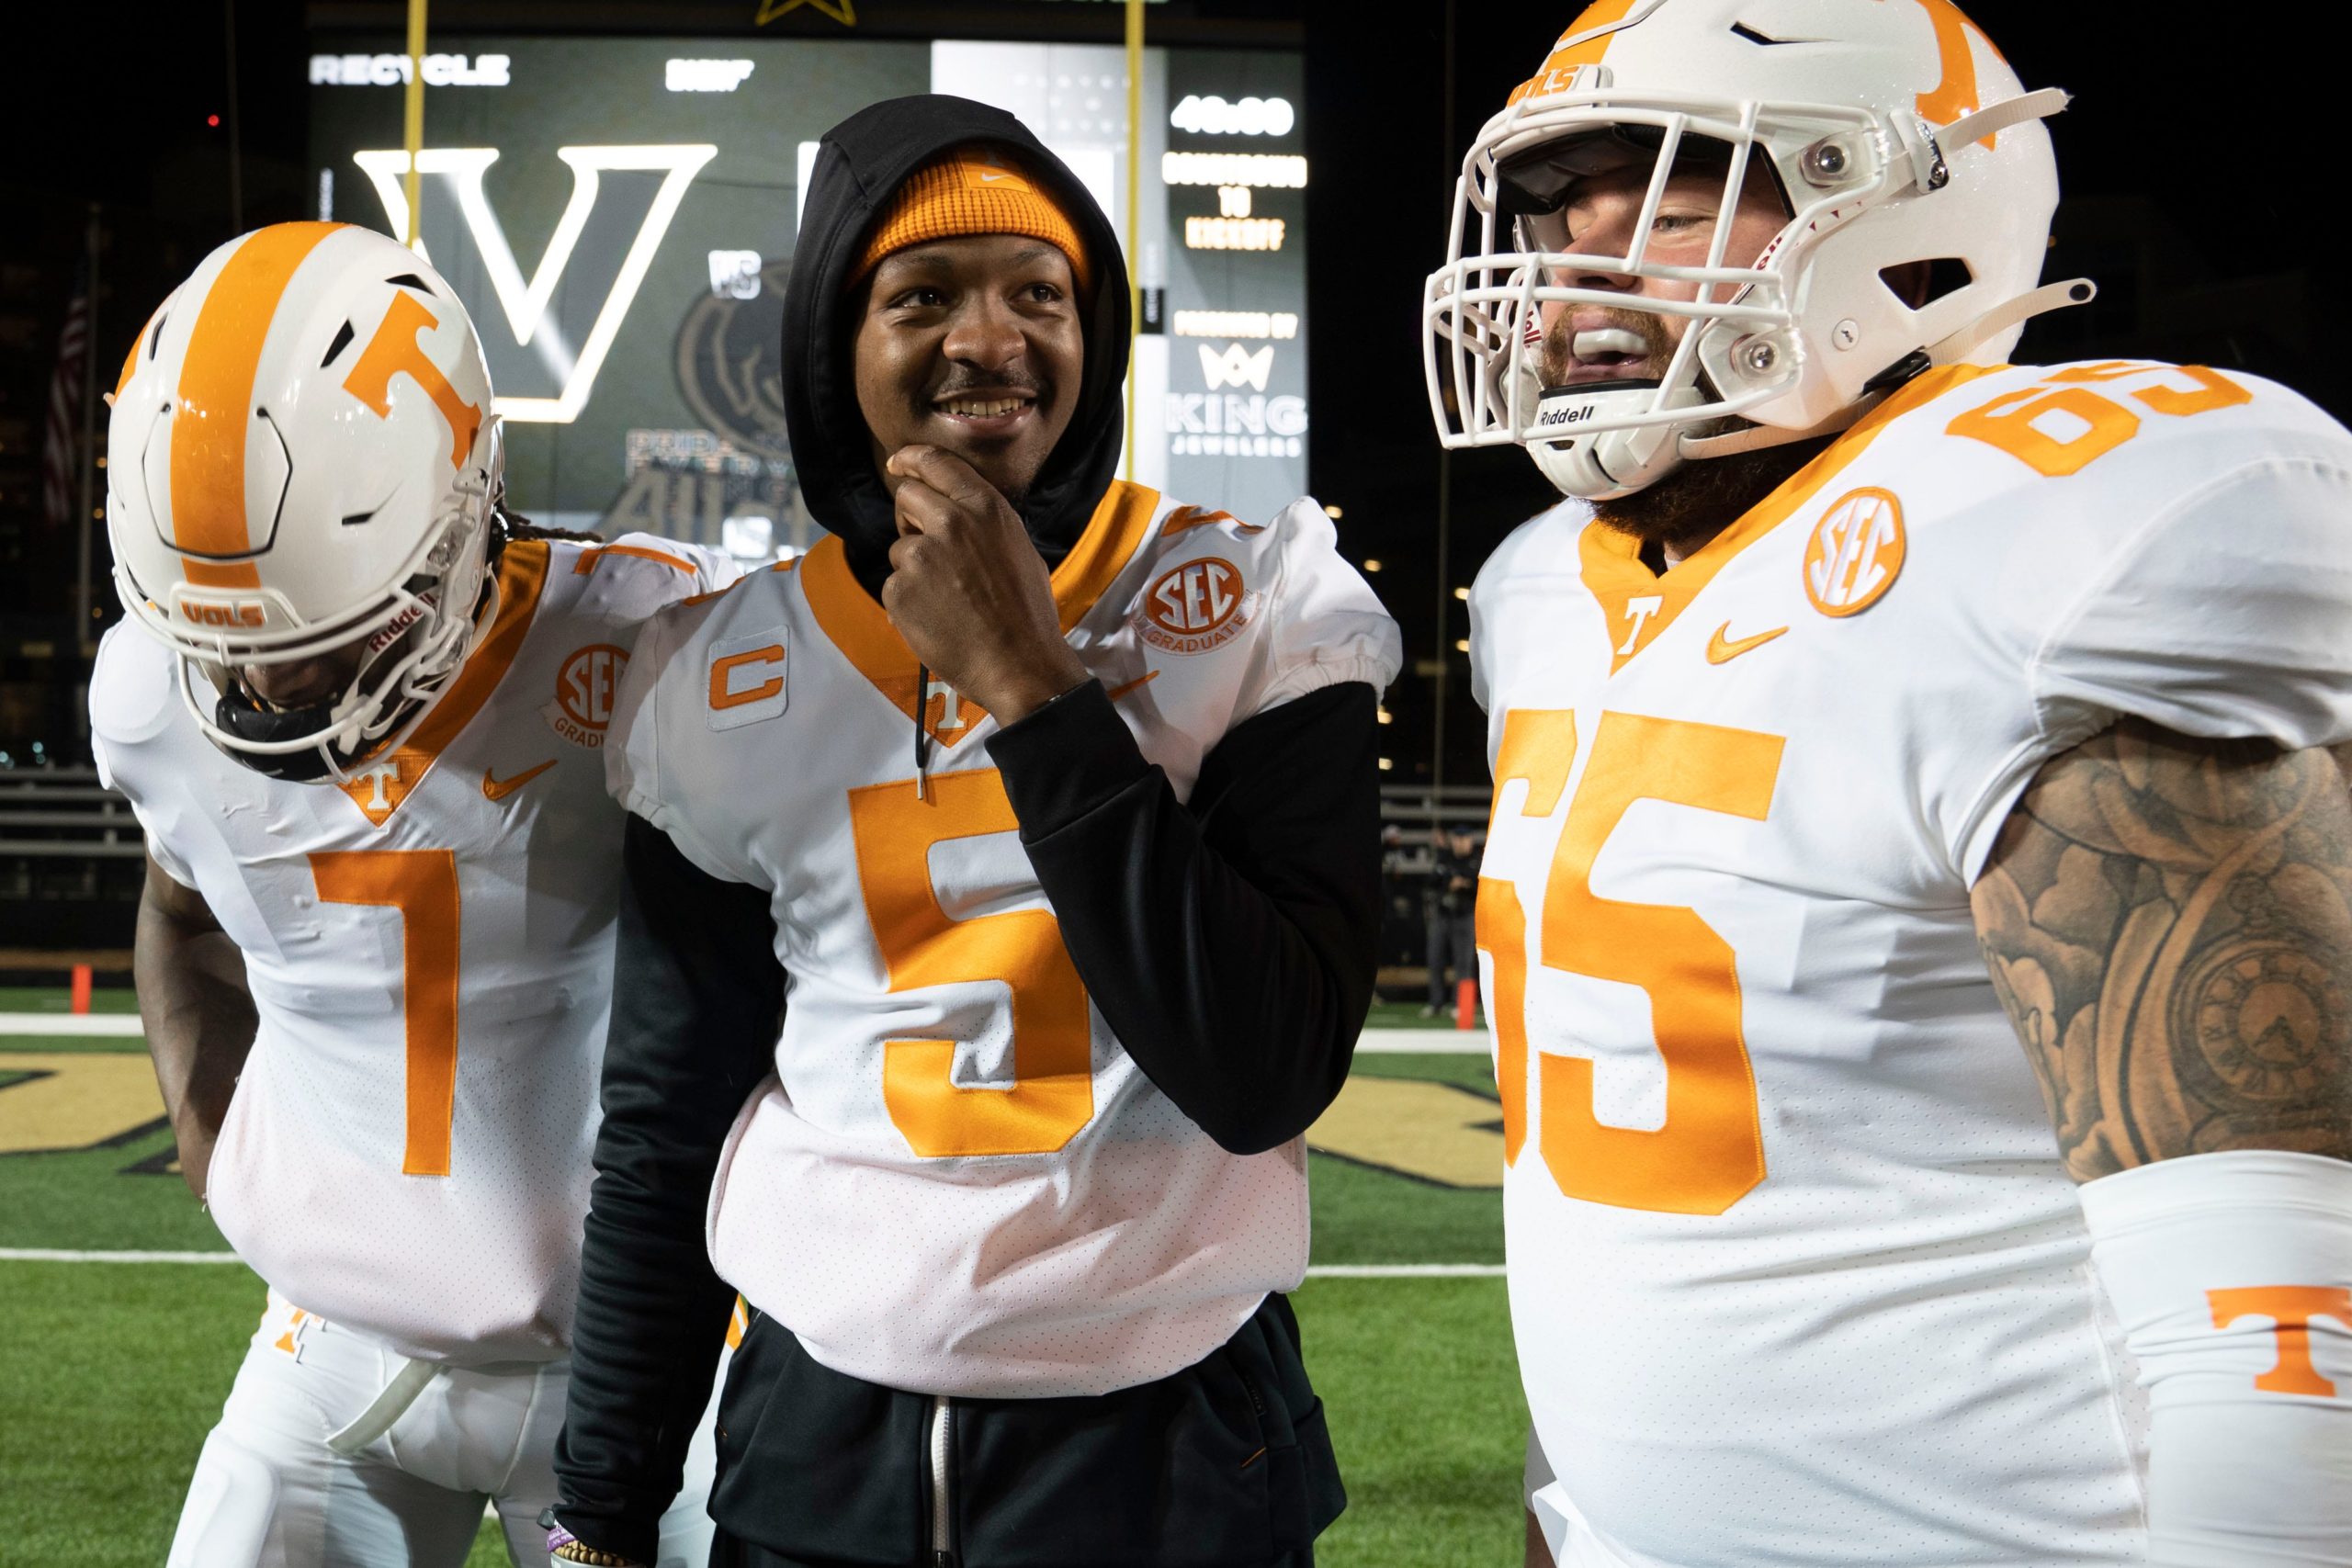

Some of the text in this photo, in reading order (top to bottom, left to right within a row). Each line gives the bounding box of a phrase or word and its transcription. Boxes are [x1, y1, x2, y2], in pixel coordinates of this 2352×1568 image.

[342, 288, 481, 471] T
[1165, 392, 1308, 436] KING
[1540, 405, 1595, 426] Riddell
[1944, 361, 2254, 478] 65
[1810, 496, 1895, 606] SEC
[180, 601, 264, 628] VOLS
[1155, 562, 1235, 630] SEC
[1614, 595, 1664, 657] T
[1148, 613, 1248, 653] GRADUATE
[709, 644, 785, 711] C
[357, 761, 399, 810] T
[847, 767, 1094, 1157] 5
[1475, 708, 1786, 1216] 65
[2206, 1284, 2352, 1398] T
